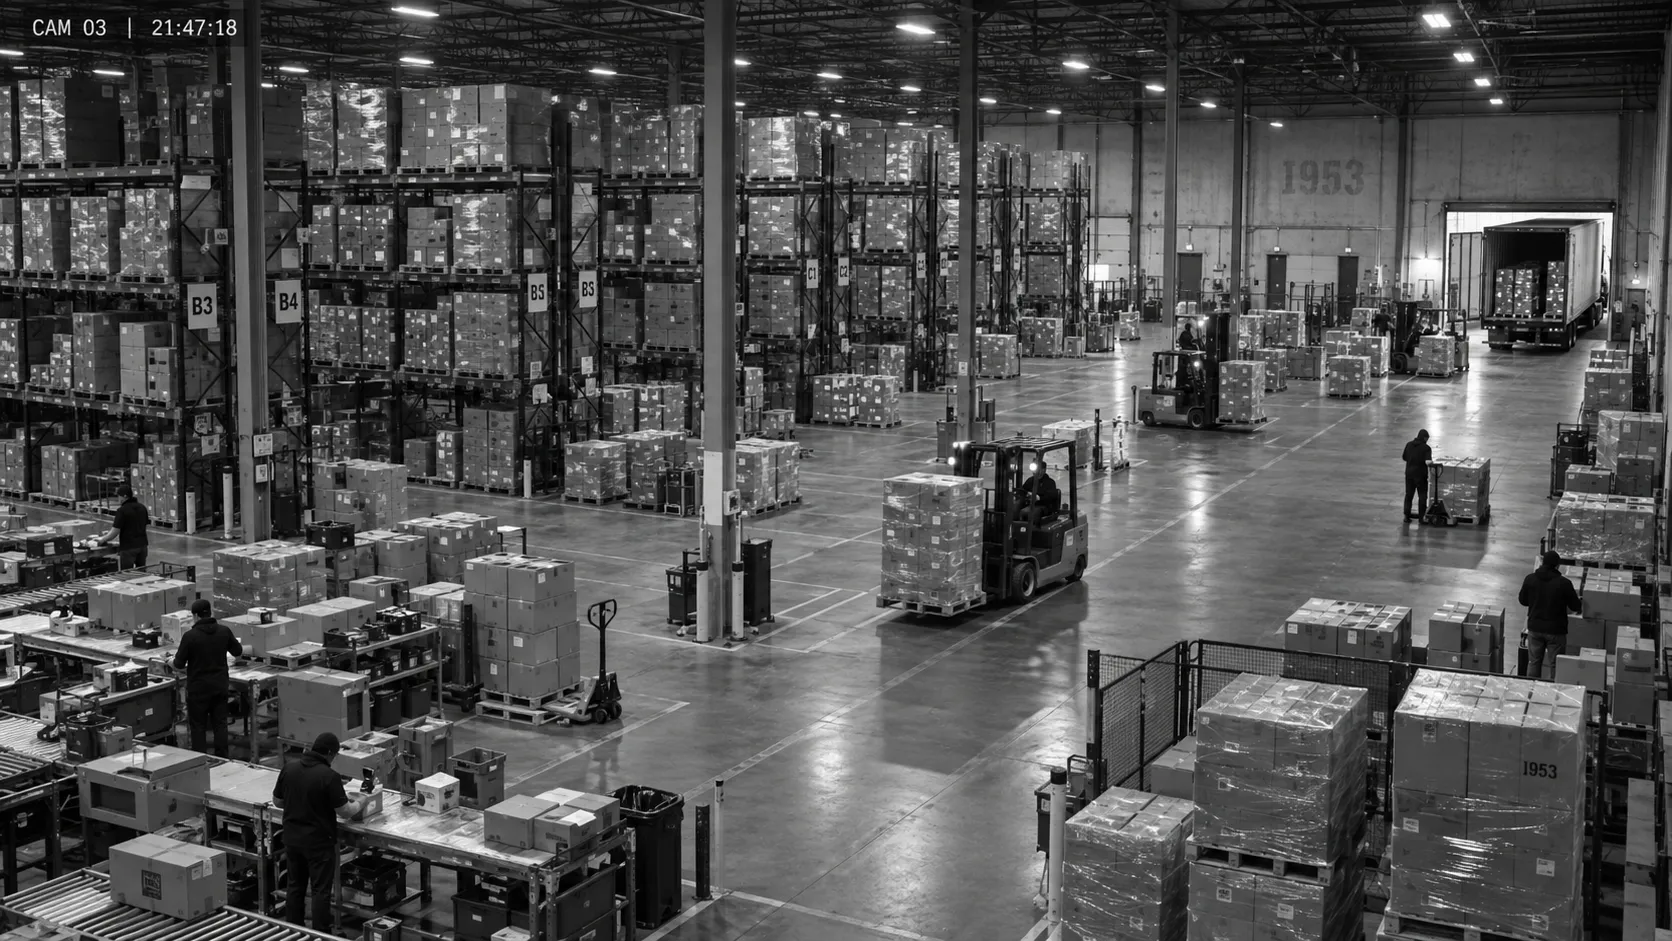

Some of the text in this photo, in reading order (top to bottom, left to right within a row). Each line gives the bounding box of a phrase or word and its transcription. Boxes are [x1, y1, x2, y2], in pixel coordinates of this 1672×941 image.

[1282, 159, 1364, 195] 1953
[808, 267, 816, 280] C1
[840, 265, 848, 277] C2
[192, 296, 213, 315] B3
[279, 292, 298, 311] B4
[1523, 761, 1557, 779] 1953
